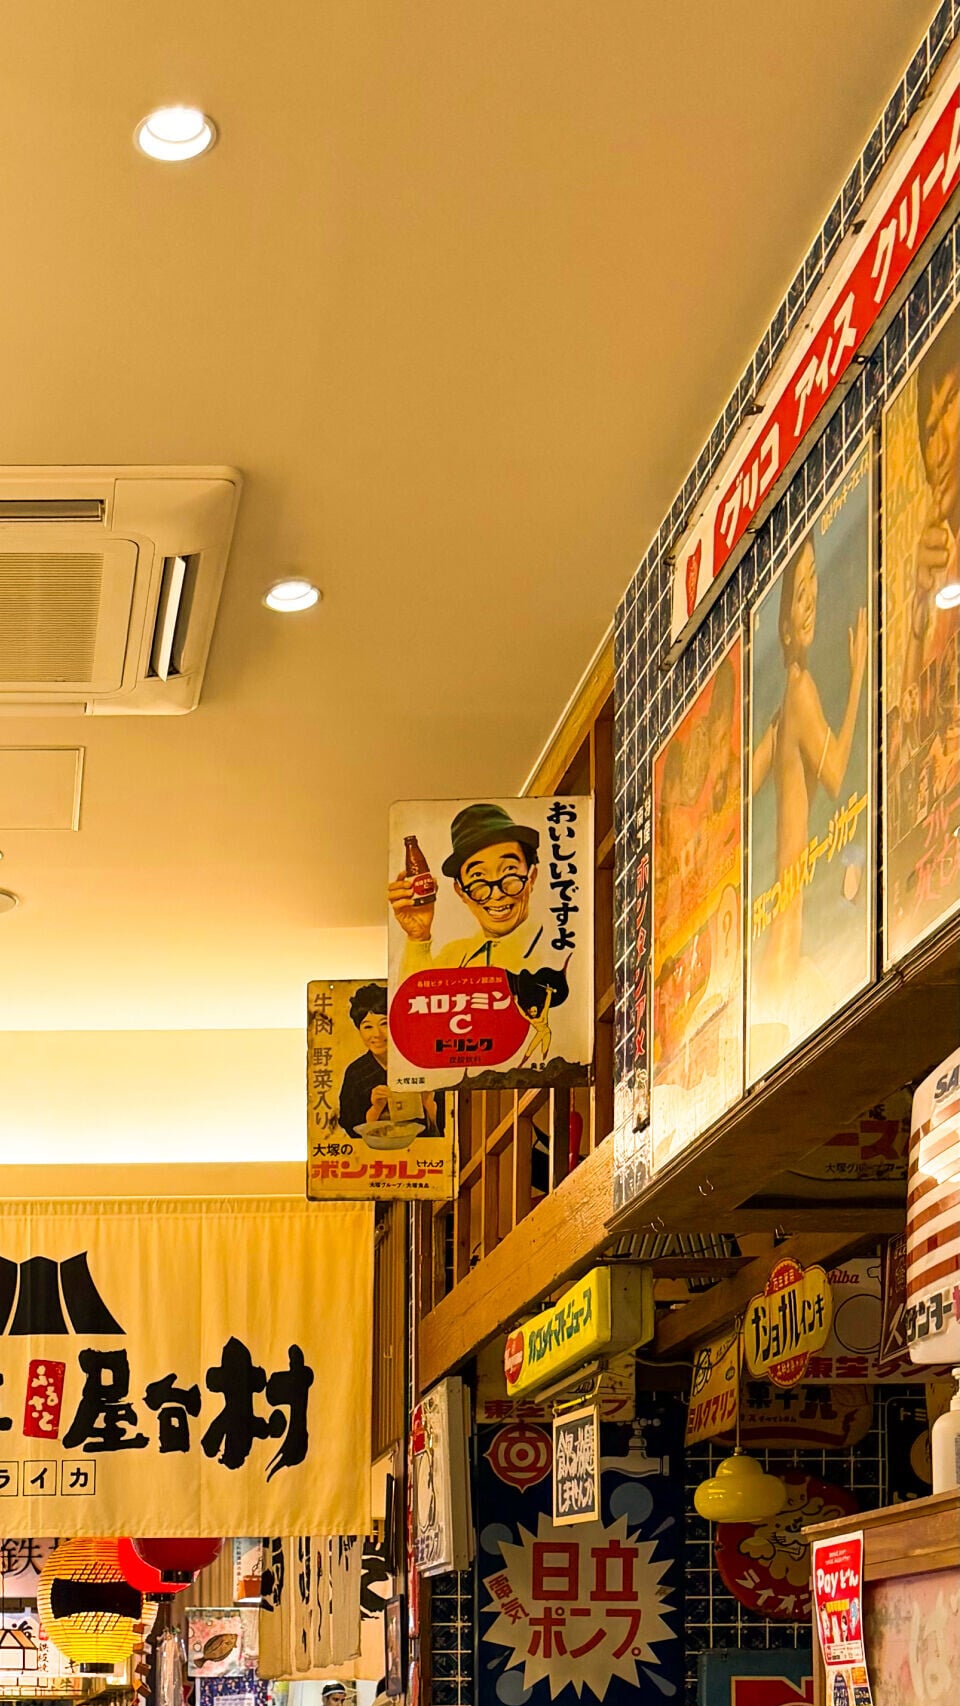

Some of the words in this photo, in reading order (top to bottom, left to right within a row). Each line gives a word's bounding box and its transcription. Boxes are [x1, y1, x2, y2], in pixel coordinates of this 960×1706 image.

[719, 421, 780, 549] グリコ
[792, 291, 857, 437] アイス
[545, 800, 579, 951] おいしいですよ
[408, 990, 511, 1015] オロナミン
[448, 1013, 473, 1035] C
[435, 1038, 493, 1053] ドリンク
[312, 1143, 353, 1157] 大塚の
[311, 1160, 443, 1180] ボンカレー
[531, 1539, 639, 1602] 日立
[734, 1568, 812, 1614] ライオ
[527, 1606, 642, 1660] ポンプ
